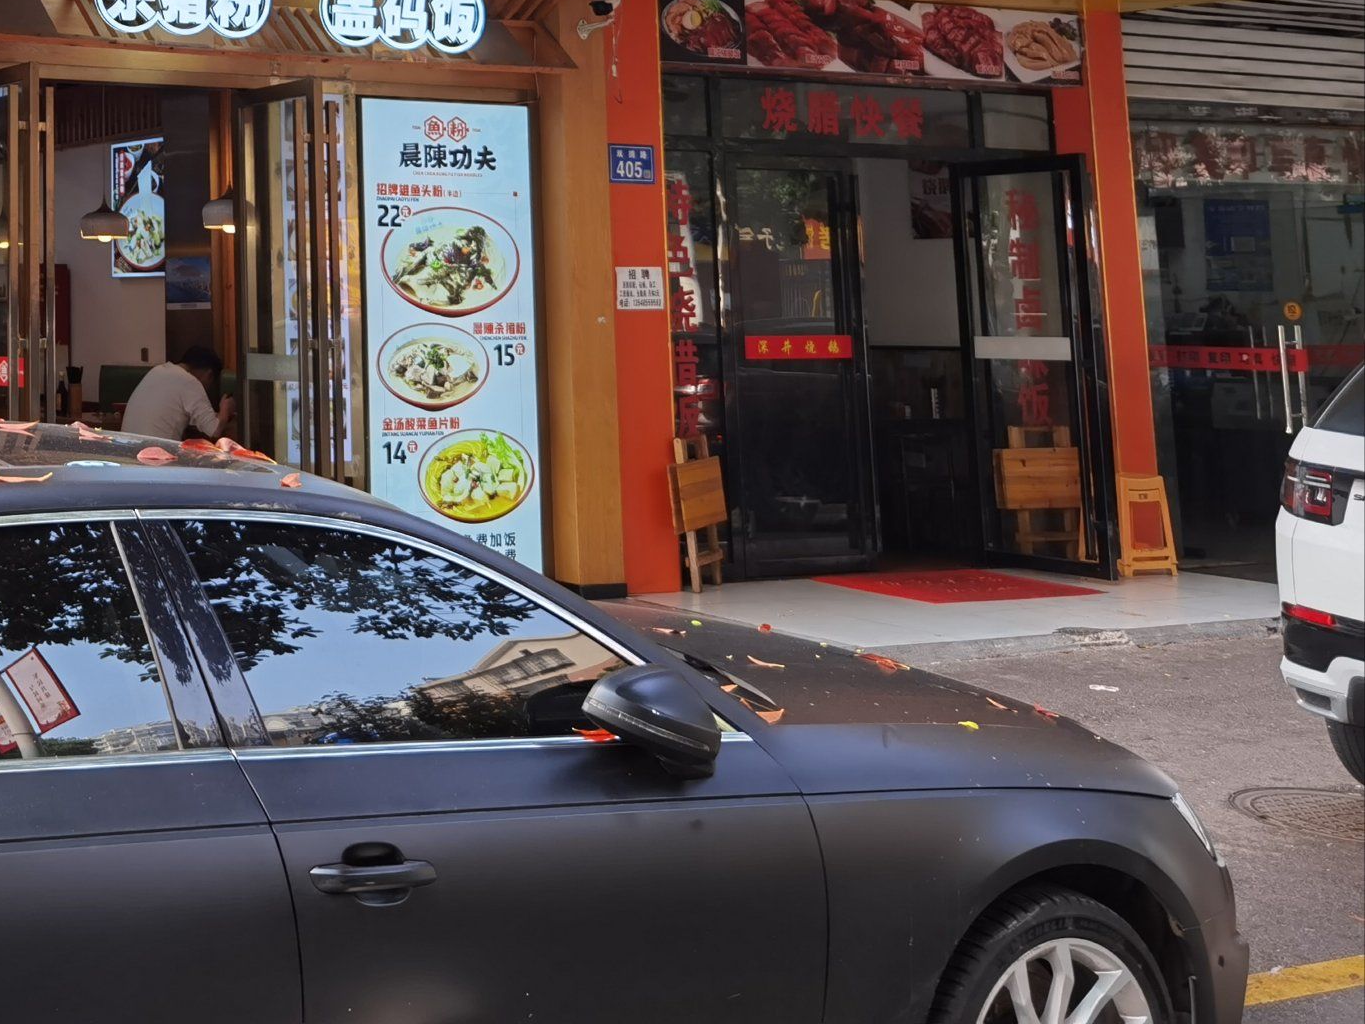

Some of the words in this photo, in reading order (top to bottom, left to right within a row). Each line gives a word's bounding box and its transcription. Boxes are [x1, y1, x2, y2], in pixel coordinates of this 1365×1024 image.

[760, 86, 924, 139] 烧腊快餐
[399, 142, 497, 171] 晨陳功夫
[616, 160, 643, 178] 405
[464, 531, 516, 547] 费加饭
